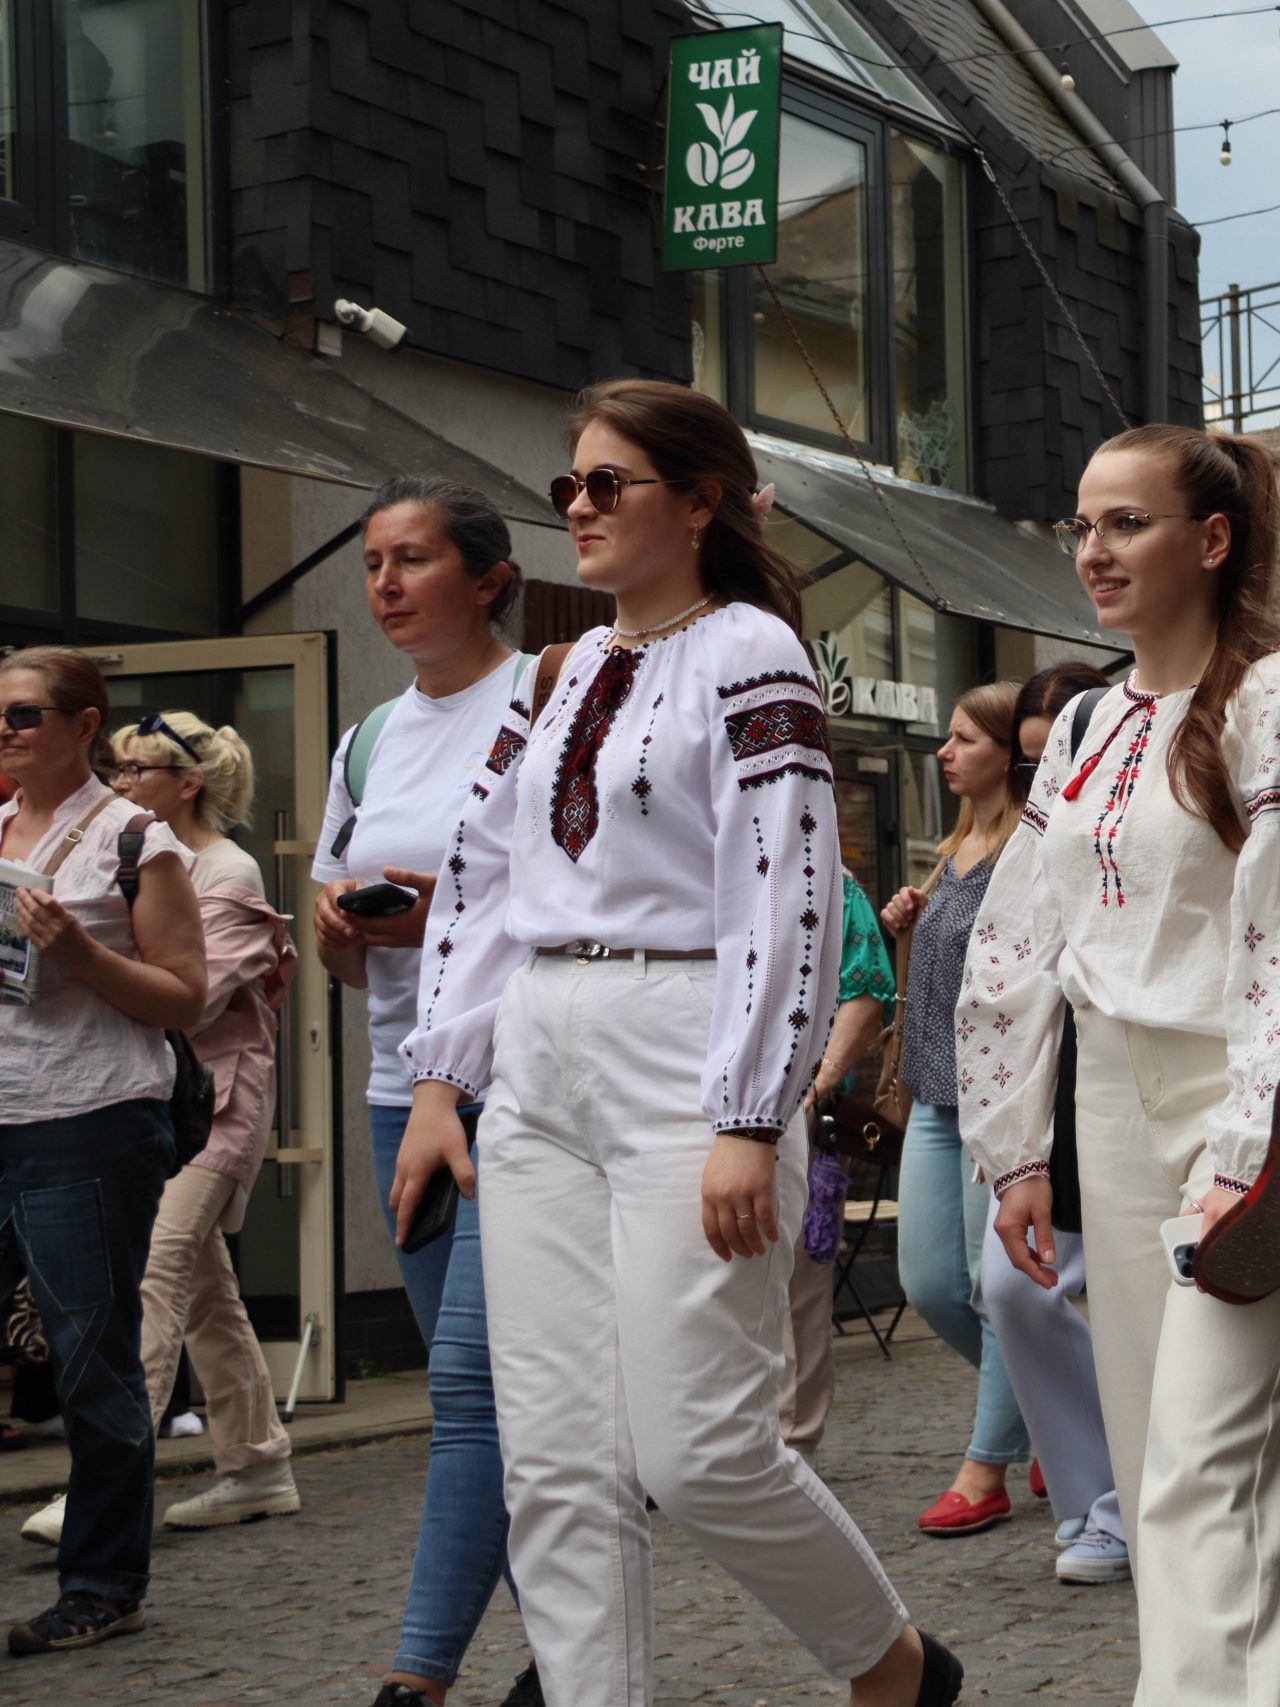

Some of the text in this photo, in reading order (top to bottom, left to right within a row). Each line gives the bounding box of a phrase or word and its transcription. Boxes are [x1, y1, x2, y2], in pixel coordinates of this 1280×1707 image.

[688, 48, 761, 90] ЧАЙ
[673, 199, 766, 233] КАВА
[693, 235, 745, 252] Форте
[852, 676, 939, 724] КАВА
